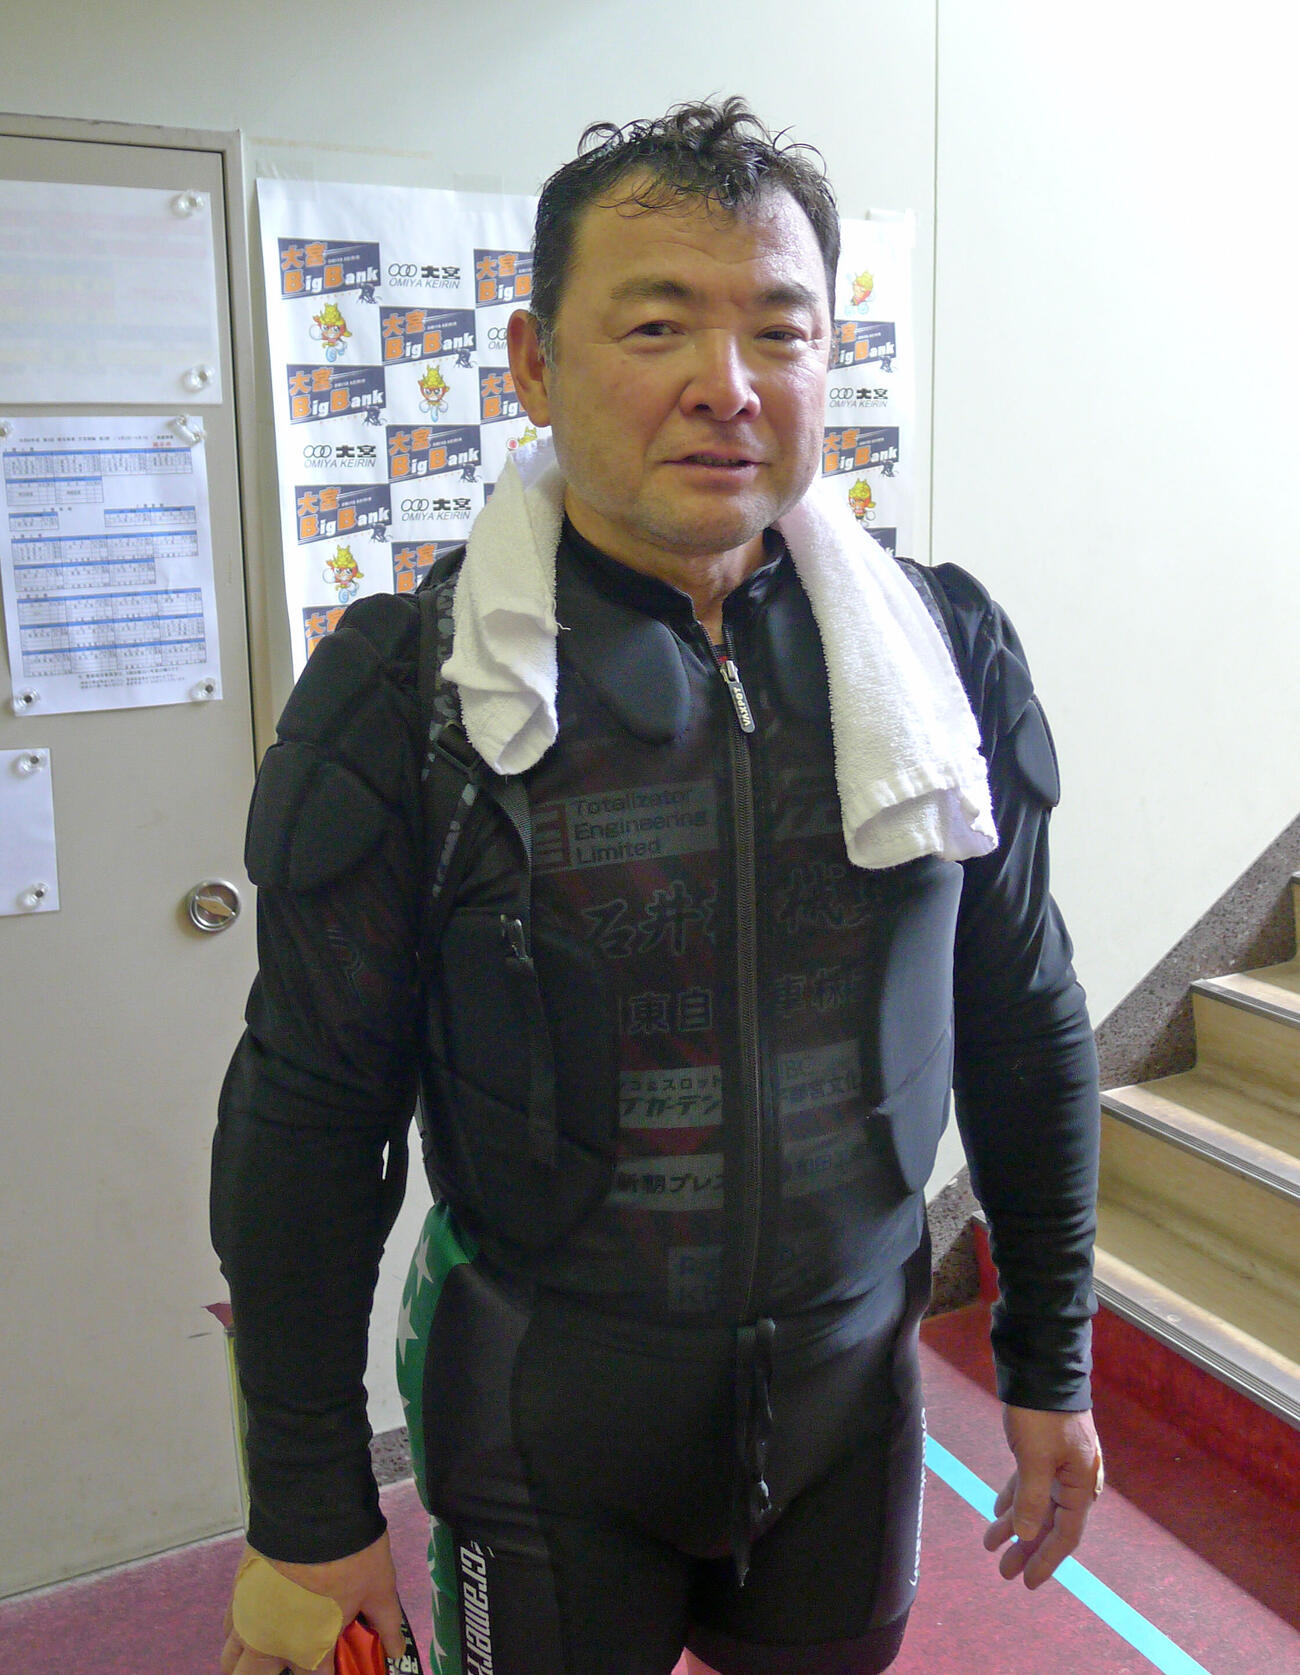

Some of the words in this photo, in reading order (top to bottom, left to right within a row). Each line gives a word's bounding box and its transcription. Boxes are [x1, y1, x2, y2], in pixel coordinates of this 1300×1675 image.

[281, 241, 327, 270] 大宮
[476, 253, 518, 280] 大宮
[389, 278, 422, 287] OMIYA
[425, 279, 460, 289] KEIRIN
[421, 265, 461, 279] 大宮
[383, 309, 427, 338] 大宮
[289, 367, 334, 396] 大宮
[856, 388, 888, 400] 大宮
[829, 400, 857, 409] OMIYA
[858, 400, 887, 409] KEIRIN
[336, 445, 376, 458] 大宮
[389, 427, 432, 456] 大宮
[823, 428, 860, 453] 大宮
[304, 459, 337, 468] OMIYA
[340, 458, 376, 468] KEIRIN
[297, 487, 341, 516] 大宮
[432, 498, 471, 511] 大宮
[401, 511, 435, 522] OMIYA
[436, 511, 470, 520] KEIRIN
[394, 543, 438, 572] 大宮
[572, 788, 693, 815] Totalizator
[574, 810, 707, 840] Engineering
[576, 836, 661, 864] Limited
